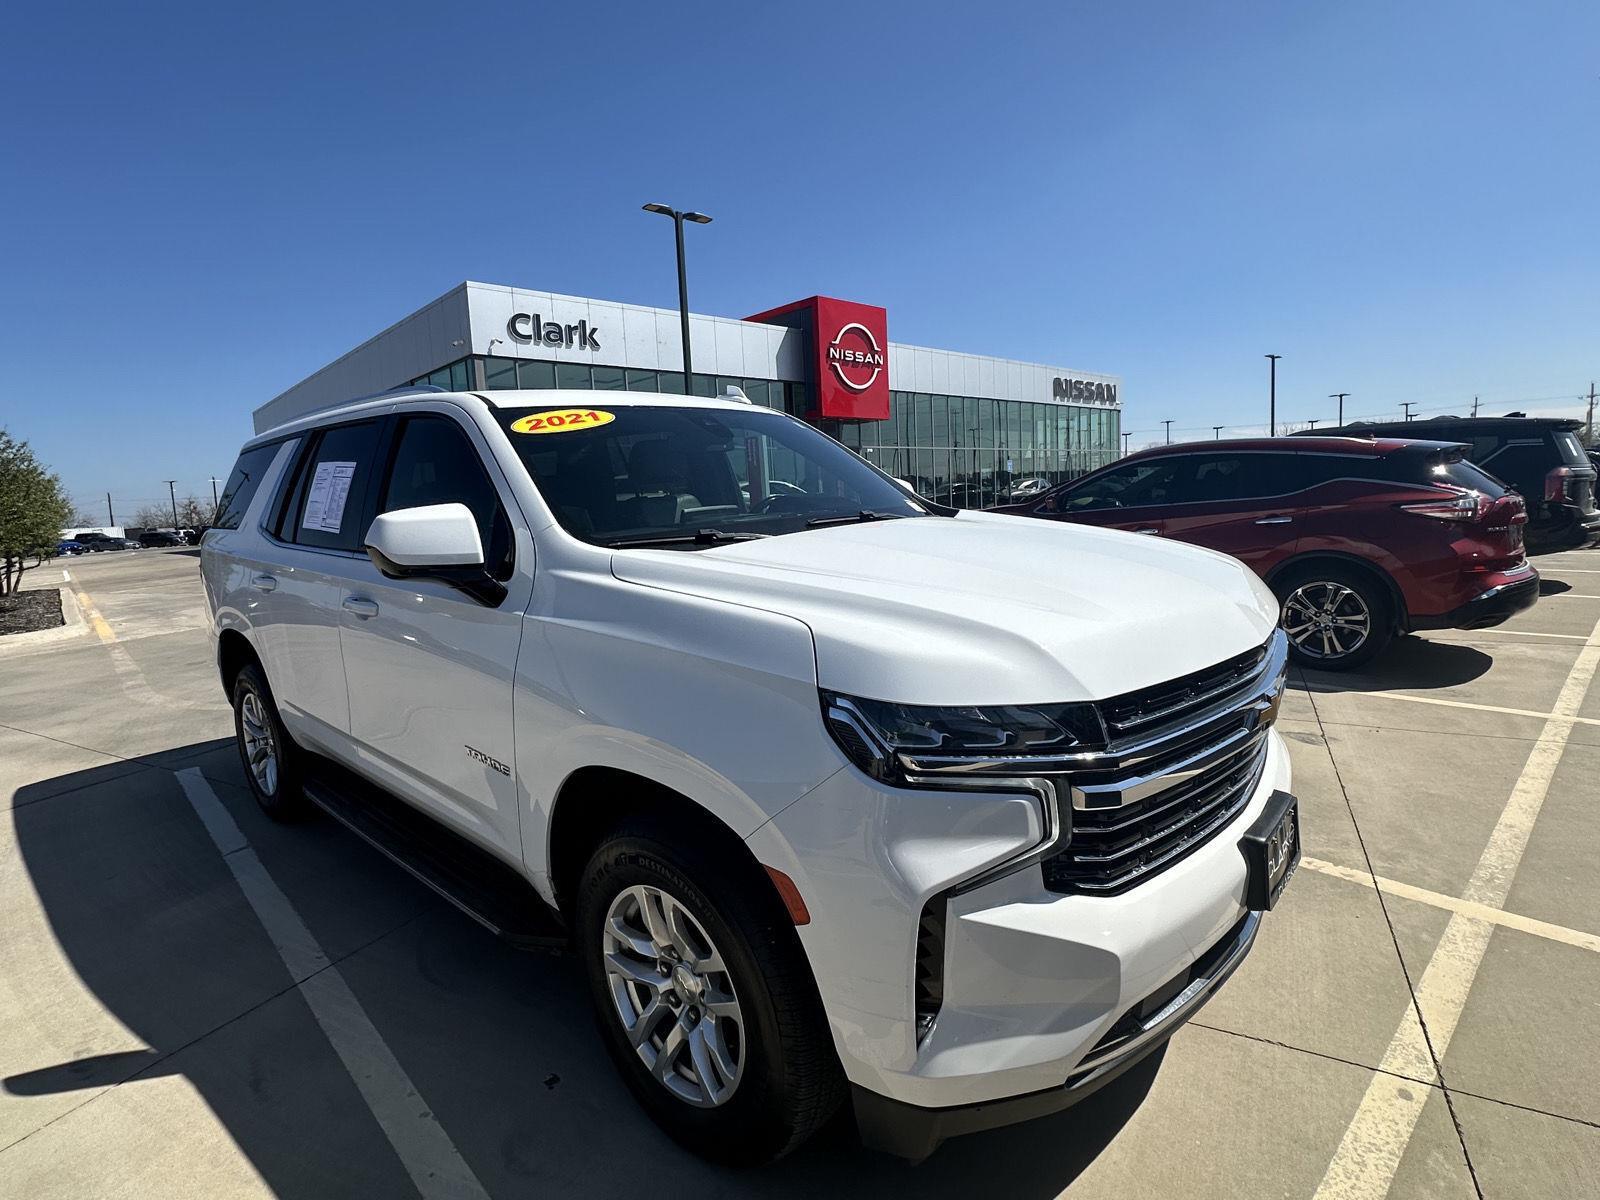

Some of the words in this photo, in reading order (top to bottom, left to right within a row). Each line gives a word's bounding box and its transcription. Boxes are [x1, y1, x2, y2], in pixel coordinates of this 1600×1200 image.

[508, 312, 600, 349] Clark
[829, 347, 884, 366] NISSAN
[1053, 377, 1117, 405] NISSAN
[525, 411, 600, 432] 2021
